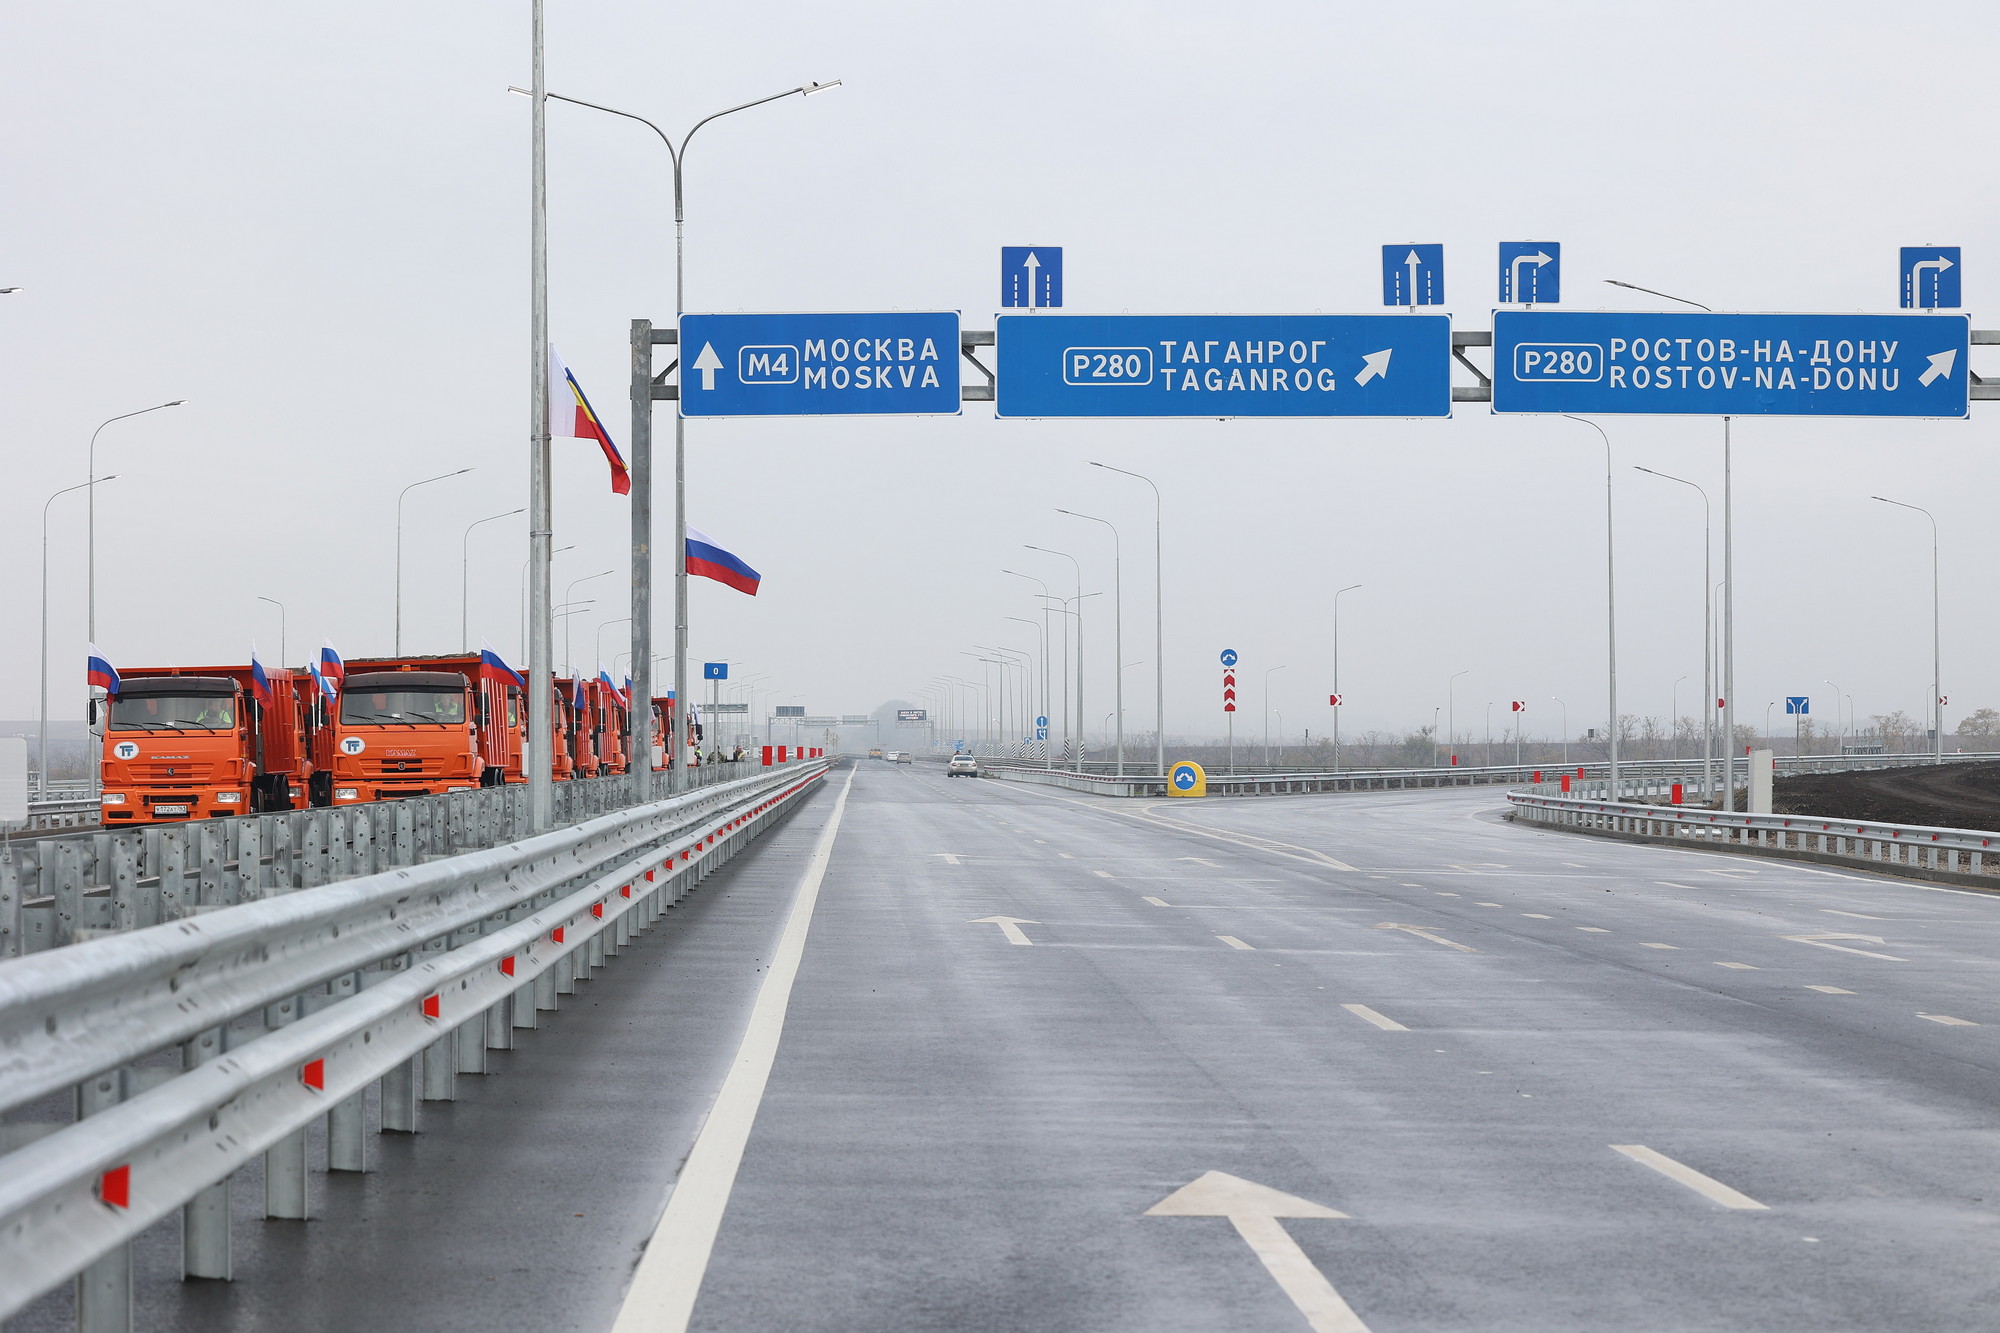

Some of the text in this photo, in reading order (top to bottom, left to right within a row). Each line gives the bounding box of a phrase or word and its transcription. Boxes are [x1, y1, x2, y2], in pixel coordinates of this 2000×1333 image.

[804, 339, 939, 361] МОСКВА
[1161, 341, 1327, 364] ТАГАНРОГ
[1611, 338, 1898, 365] РОСТОВ-НА-ДОНУ
[804, 366, 939, 390] MOSKVA
[1161, 367, 1336, 391] TAGANROG
[1610, 366, 1898, 391] ROSTOV-NA-DONU
[713, 667, 719, 675] 0
[385, 749, 417, 757] KAMAZ
